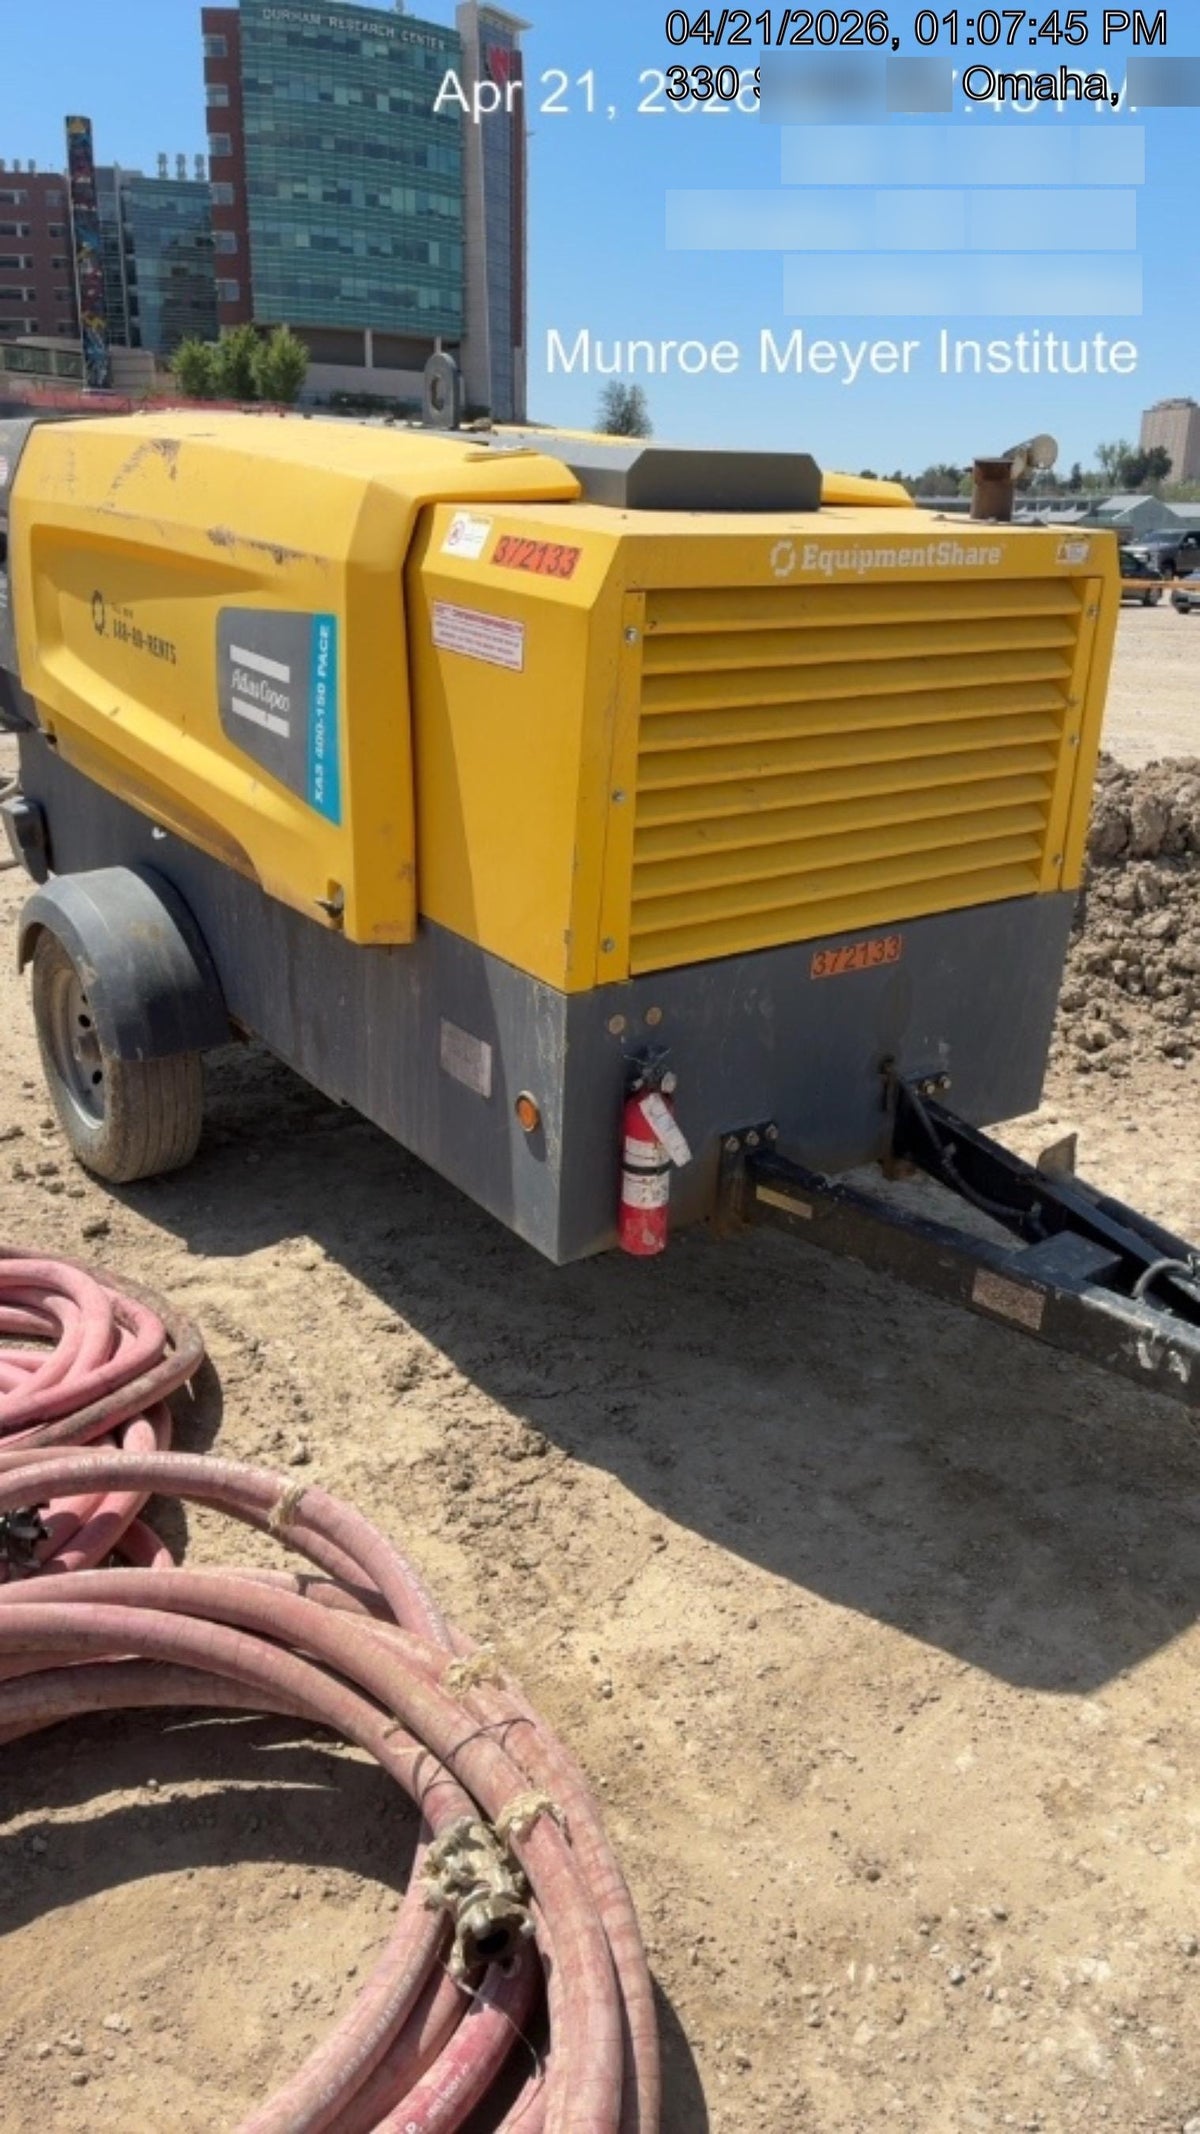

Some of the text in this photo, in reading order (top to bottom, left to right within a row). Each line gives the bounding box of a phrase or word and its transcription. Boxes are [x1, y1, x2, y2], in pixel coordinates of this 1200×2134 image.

[262, 8, 445, 51] DURHAM RESEARCH CENTER
[494, 535, 580, 577] 372133
[801, 541, 1000, 575] EquipmentShare
[317, 623, 330, 677] PACE
[314, 763, 324, 803] XAS
[813, 934, 900, 976] 372133
